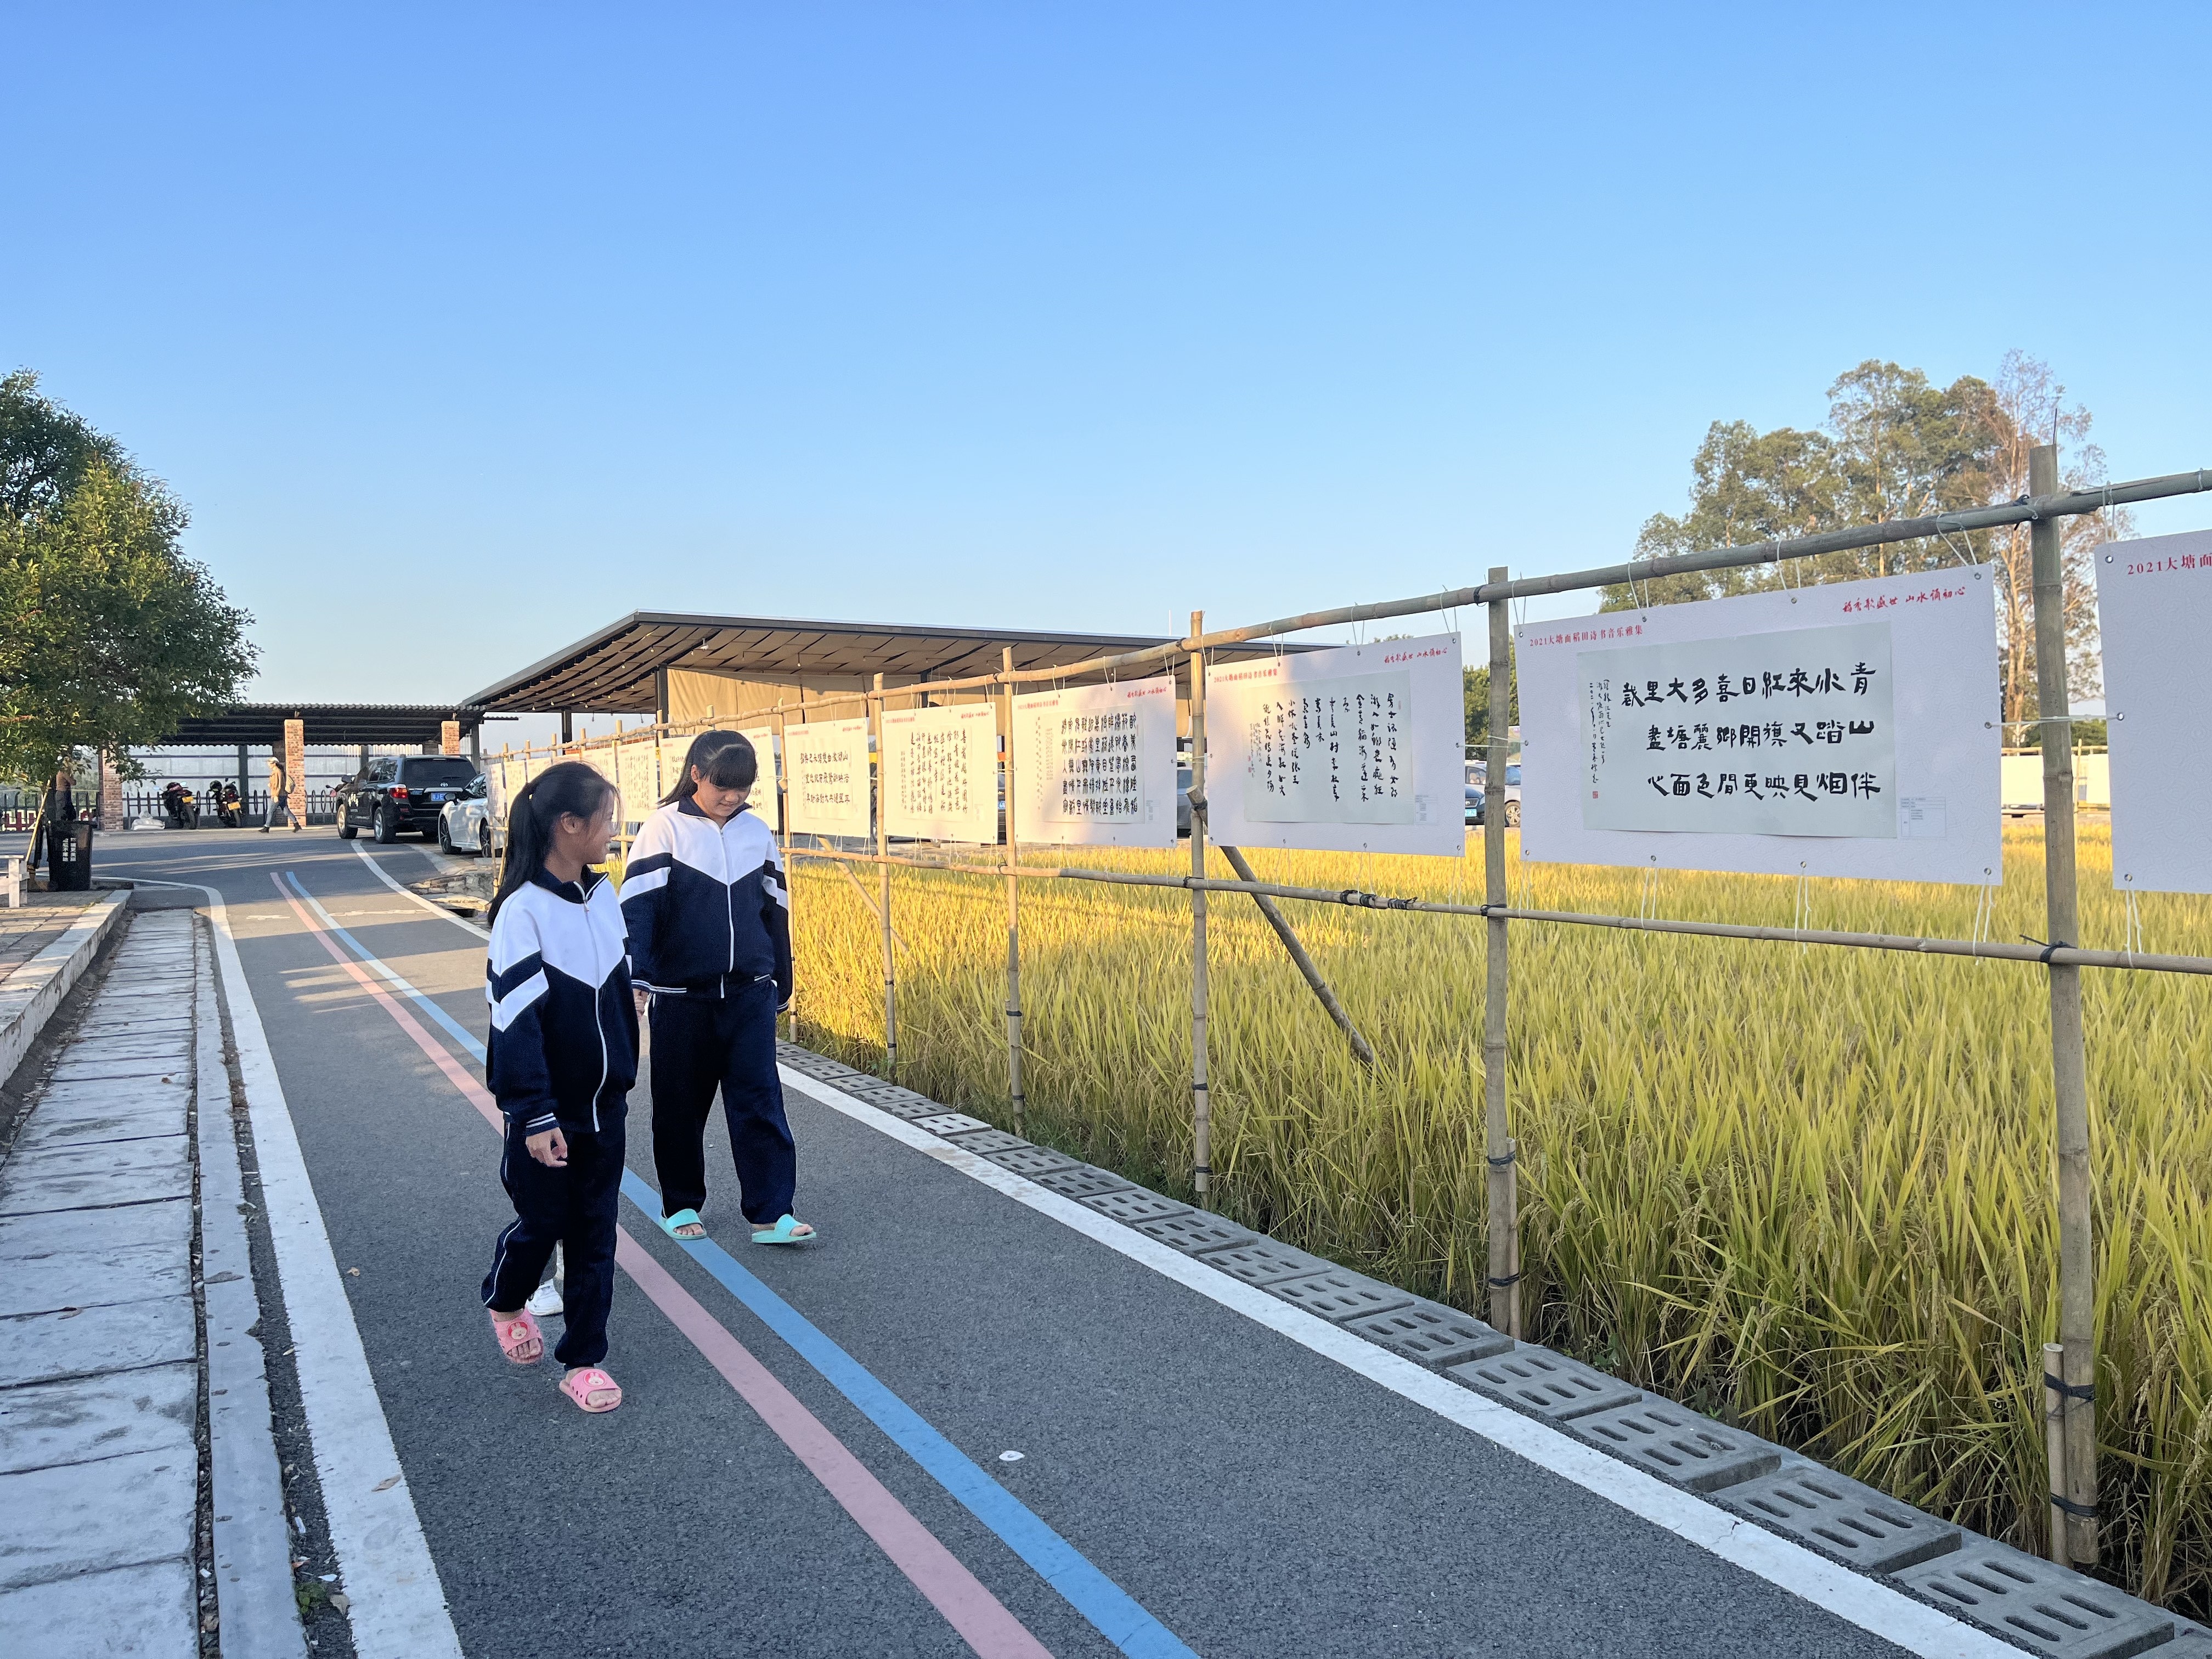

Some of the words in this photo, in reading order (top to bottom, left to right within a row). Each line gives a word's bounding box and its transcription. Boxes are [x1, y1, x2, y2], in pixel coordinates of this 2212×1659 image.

[1530, 624, 1643, 647] 2021大塘面稻田诗书音乐雅集
